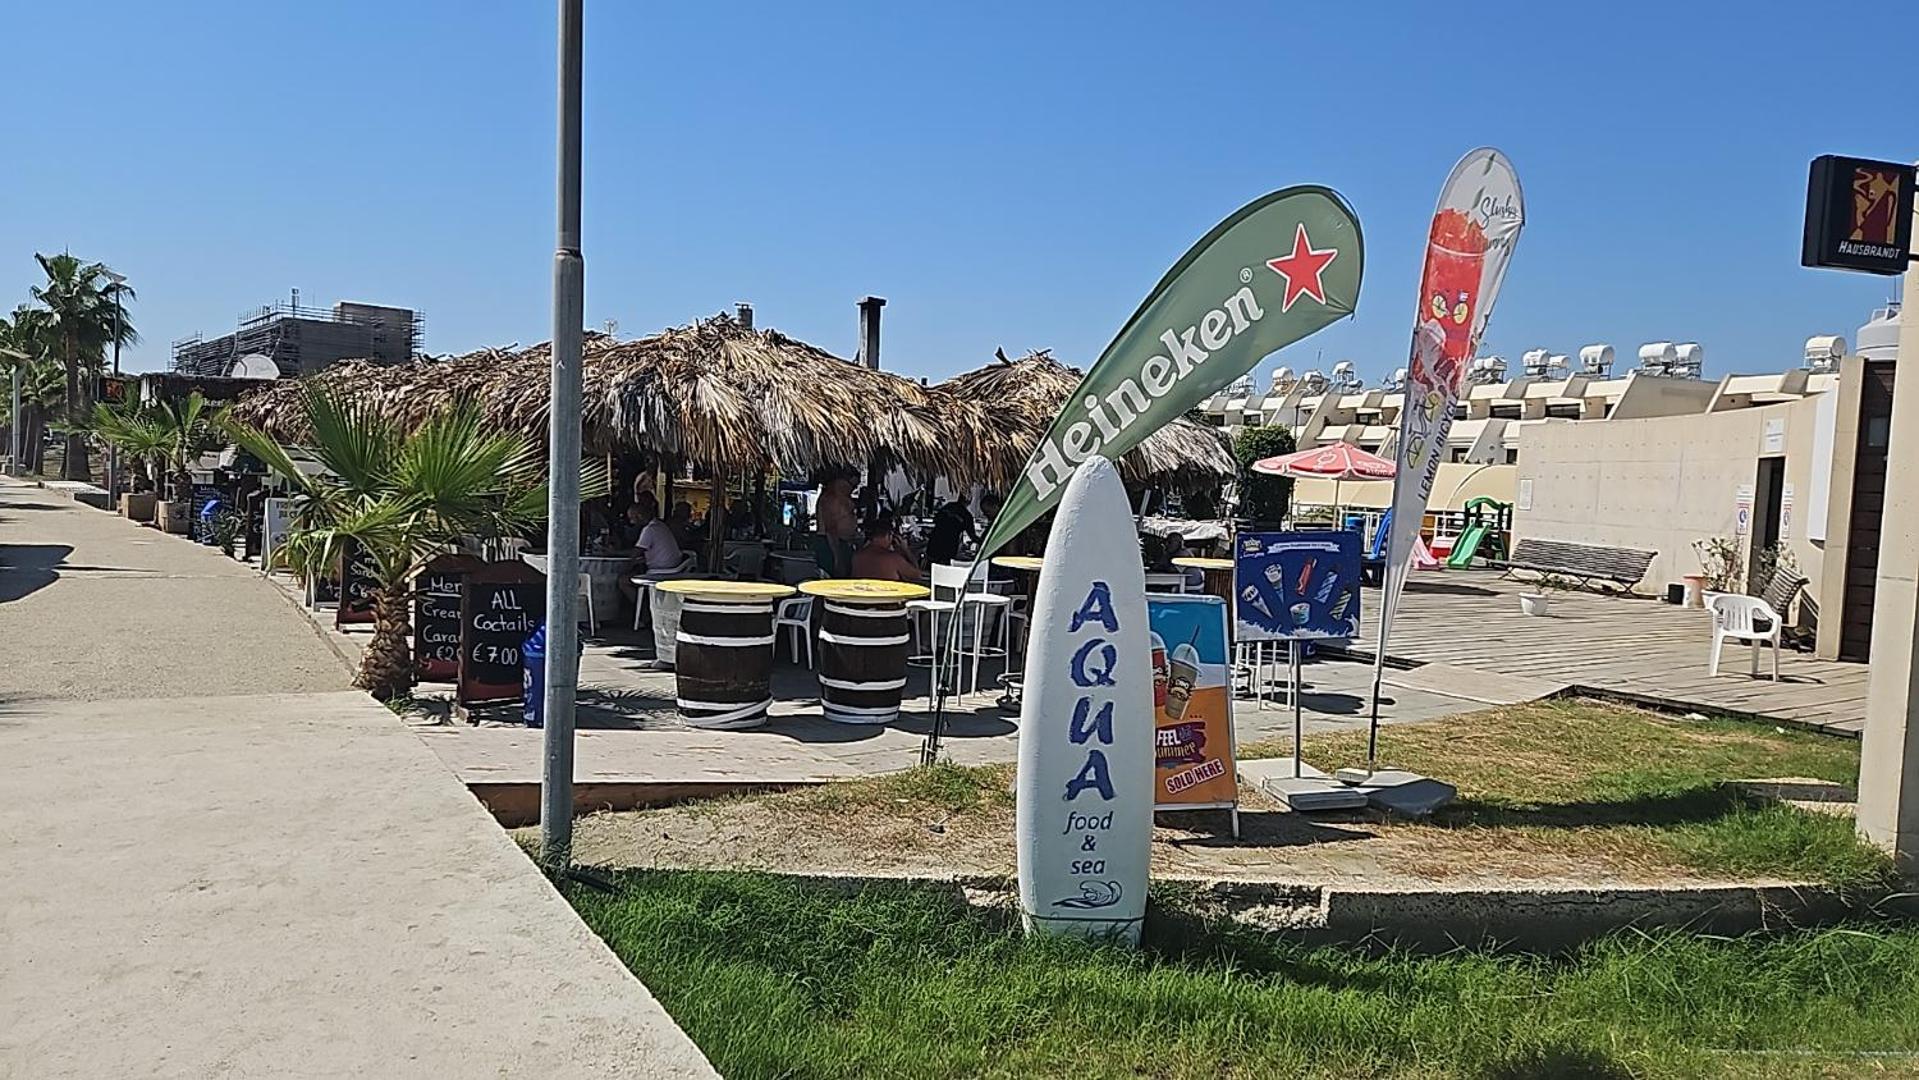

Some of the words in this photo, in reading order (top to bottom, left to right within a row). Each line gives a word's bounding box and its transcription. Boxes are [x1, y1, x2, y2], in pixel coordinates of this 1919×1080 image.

[1838, 241, 1900, 259] HAUSBRANDT
[1026, 286, 1264, 501] Heineken
[1417, 448, 1440, 501] LEMON
[491, 590, 523, 611] ALL
[473, 612, 535, 634] Coctails
[1064, 581, 1118, 801] AQUA
[1156, 729, 1181, 746] FEEL
[1166, 769, 1195, 793] SOLD
[1193, 760, 1223, 782] HERE
[1062, 810, 1114, 835] food
[1081, 834, 1096, 852] &
[1070, 860, 1105, 875] sea
